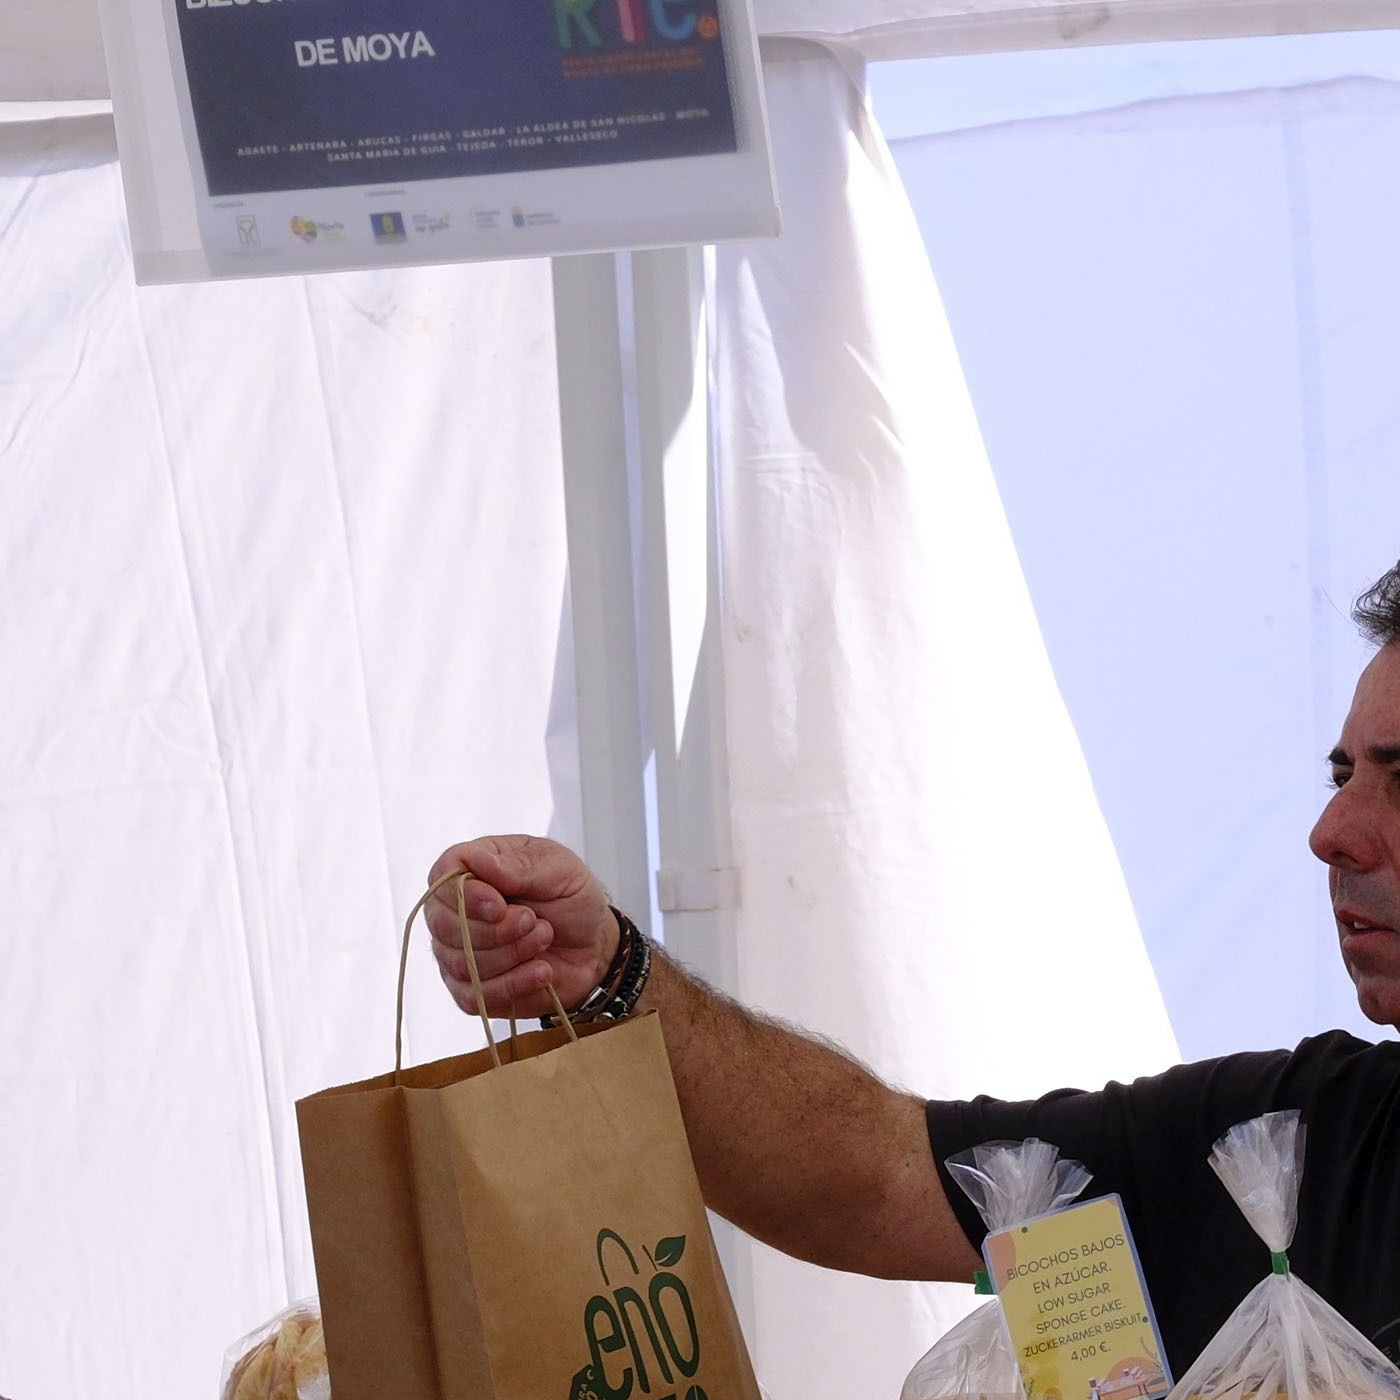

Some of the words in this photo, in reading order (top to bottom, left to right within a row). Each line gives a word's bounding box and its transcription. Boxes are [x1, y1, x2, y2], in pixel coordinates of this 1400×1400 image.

[294, 38, 338, 67] DE
[342, 30, 435, 65] MOYA
[1007, 1248, 1080, 1281] BICOCHOS
[1081, 1233, 1125, 1257] BAJOS
[1033, 1279, 1051, 1295] EN
[1037, 1296, 1065, 1314] LOW
[1068, 1282, 1111, 1305] SUGAR
[1036, 1310, 1088, 1335] SPONGE
[1024, 1324, 1103, 1358] ZUCKERARMER
[1071, 1344, 1097, 1362] 4,00
